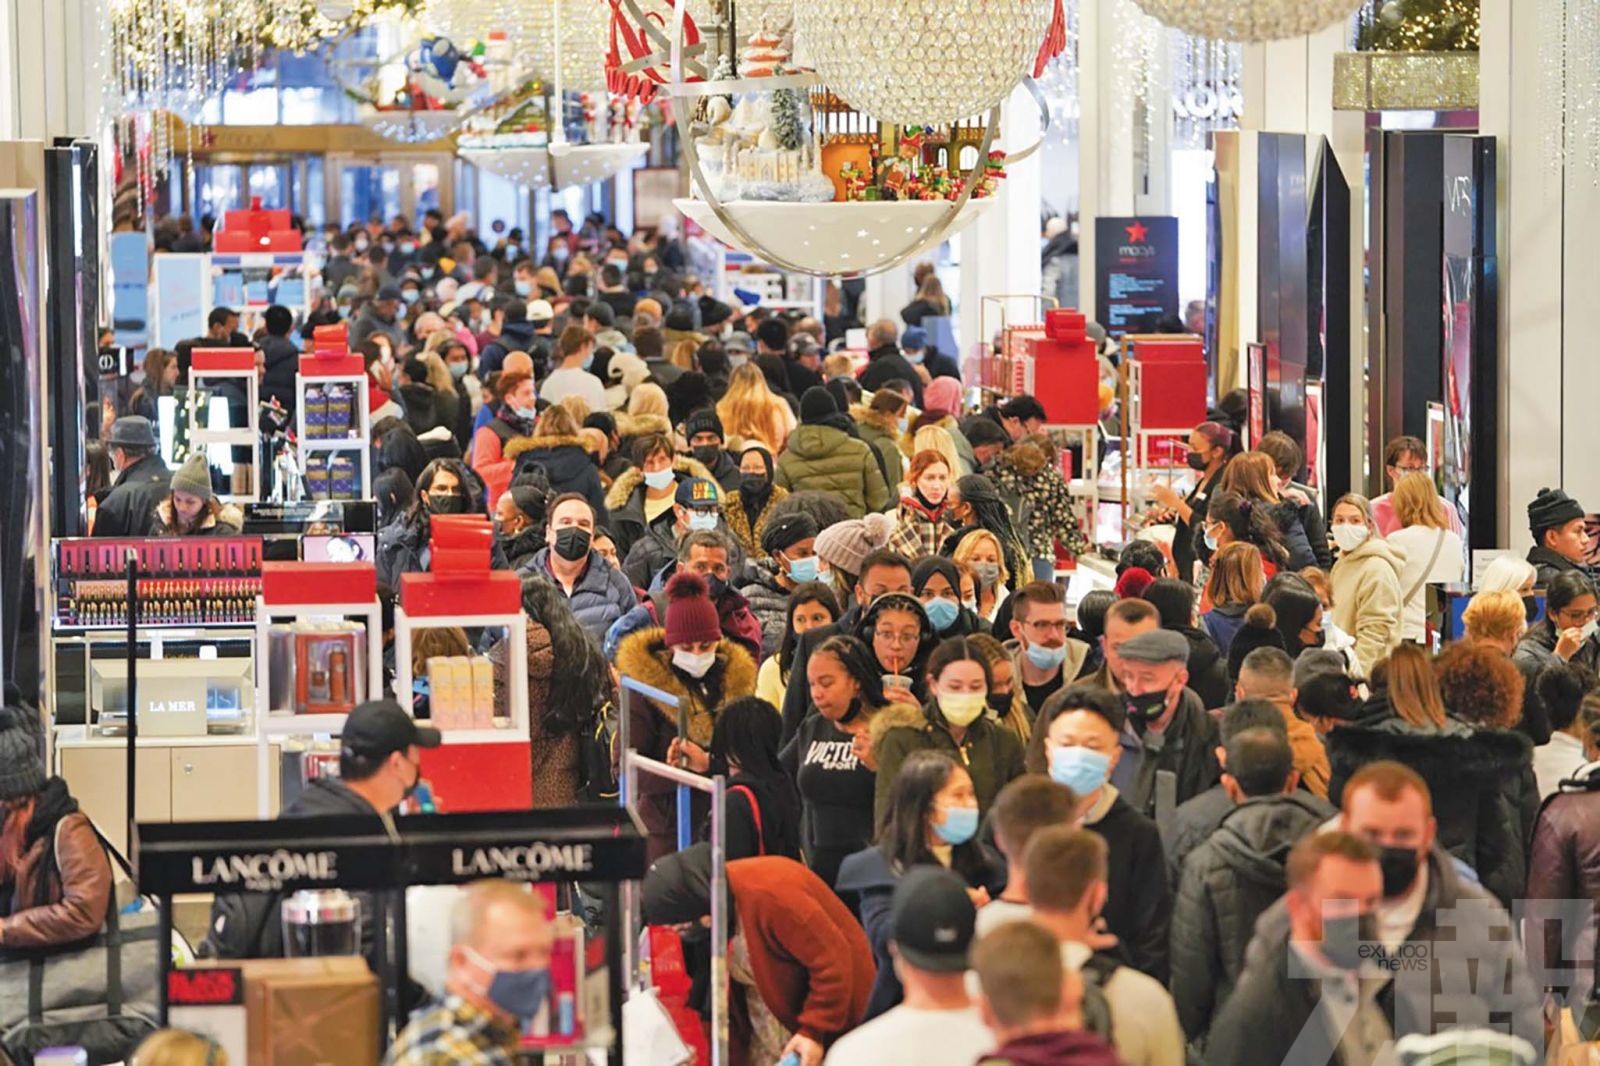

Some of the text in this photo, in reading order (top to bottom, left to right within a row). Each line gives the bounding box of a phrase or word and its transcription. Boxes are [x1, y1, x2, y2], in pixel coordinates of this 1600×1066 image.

[149, 701, 196, 712] LA MER
[192, 849, 338, 884] LANCÔME
[452, 841, 593, 876] LANCÔME
